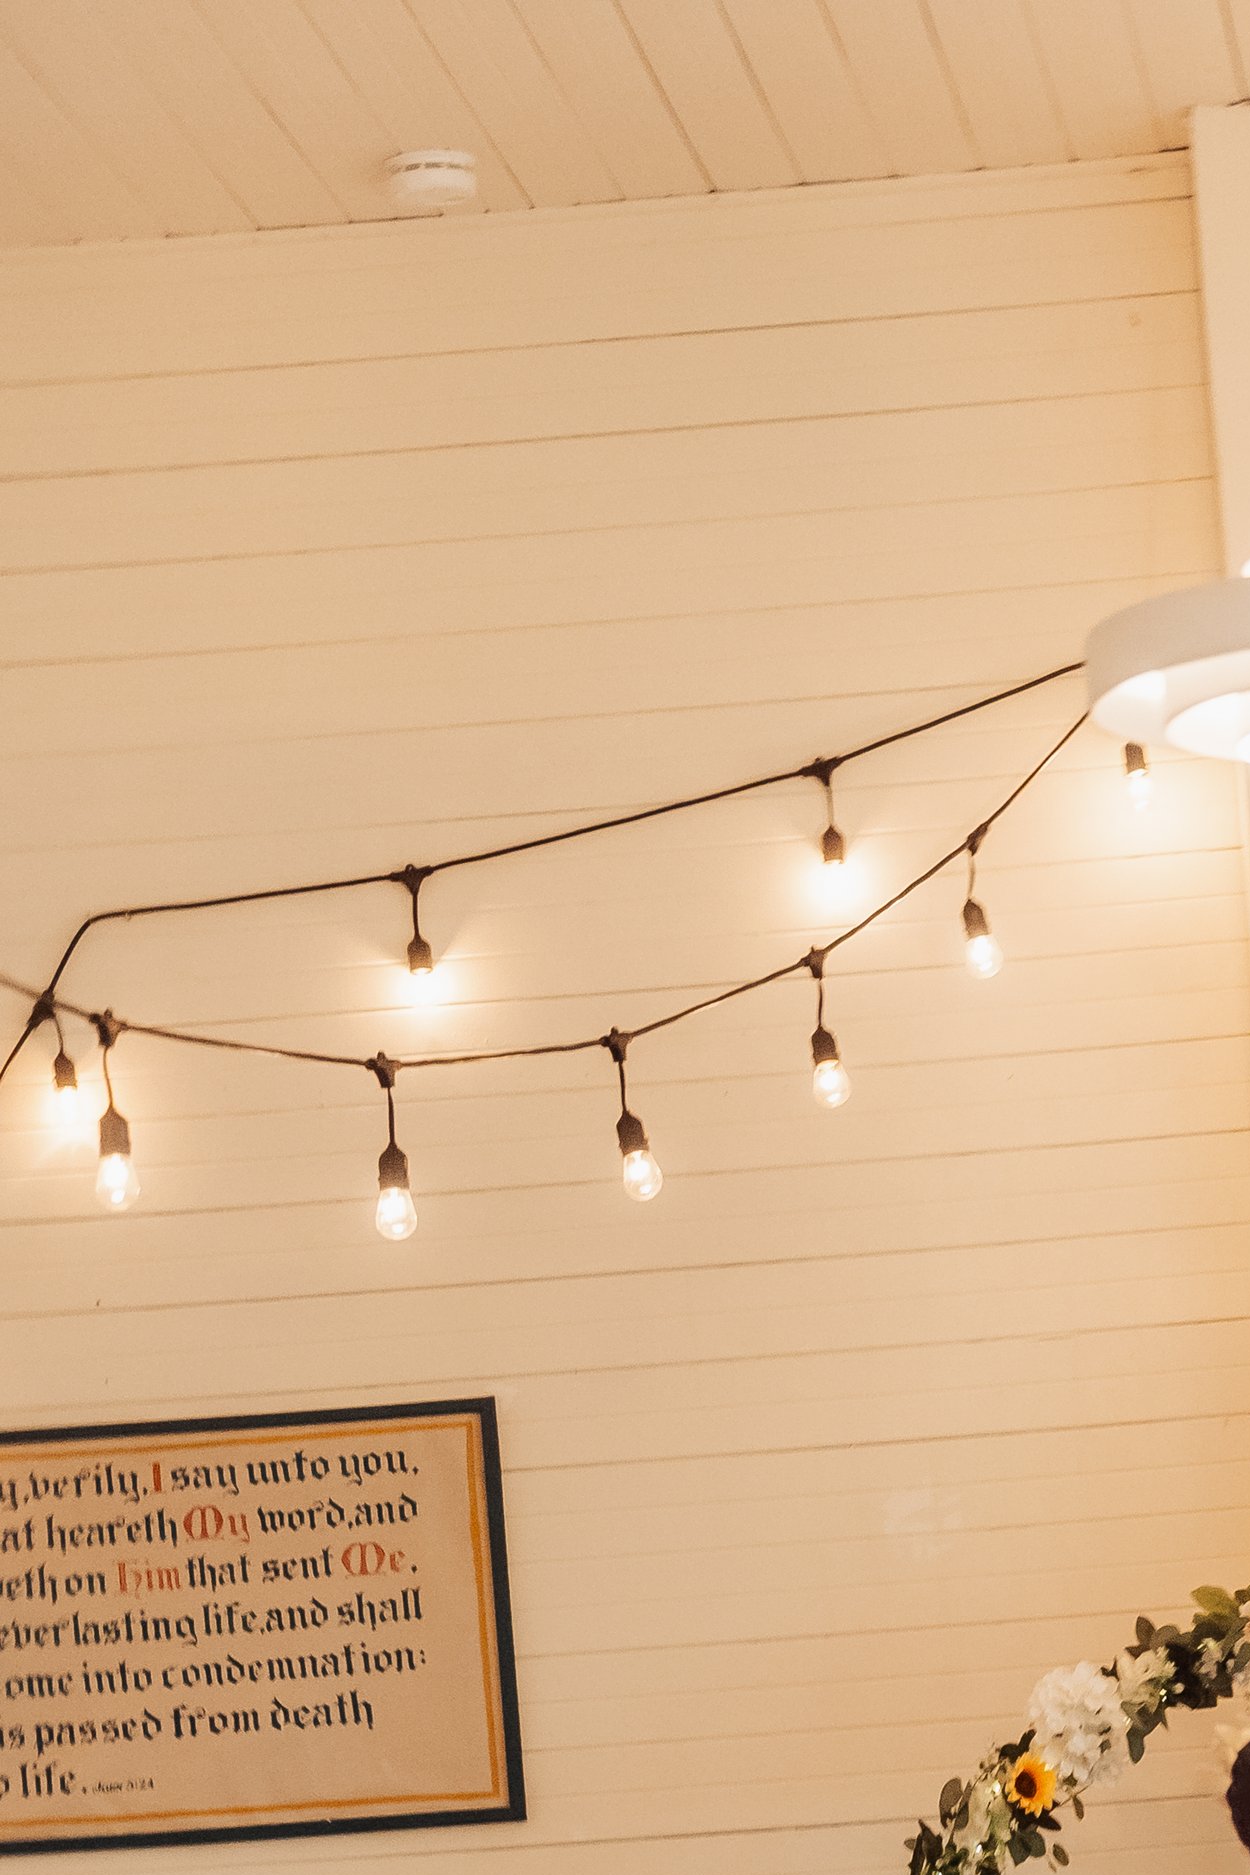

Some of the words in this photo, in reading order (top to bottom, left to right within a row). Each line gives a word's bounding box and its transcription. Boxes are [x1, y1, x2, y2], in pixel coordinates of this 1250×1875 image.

[170, 1464, 240, 1495] say
[247, 1451, 330, 1485] unto
[46, 1508, 178, 1557] heareth
[65, 1572, 106, 1596] on
[187, 1553, 250, 1593] that
[262, 1546, 333, 1584] sent
[337, 1586, 423, 1632] shall
[82, 1659, 152, 1695] into
[34, 1707, 162, 1758] passed
[171, 1703, 260, 1740] from
[270, 1689, 374, 1731] death
